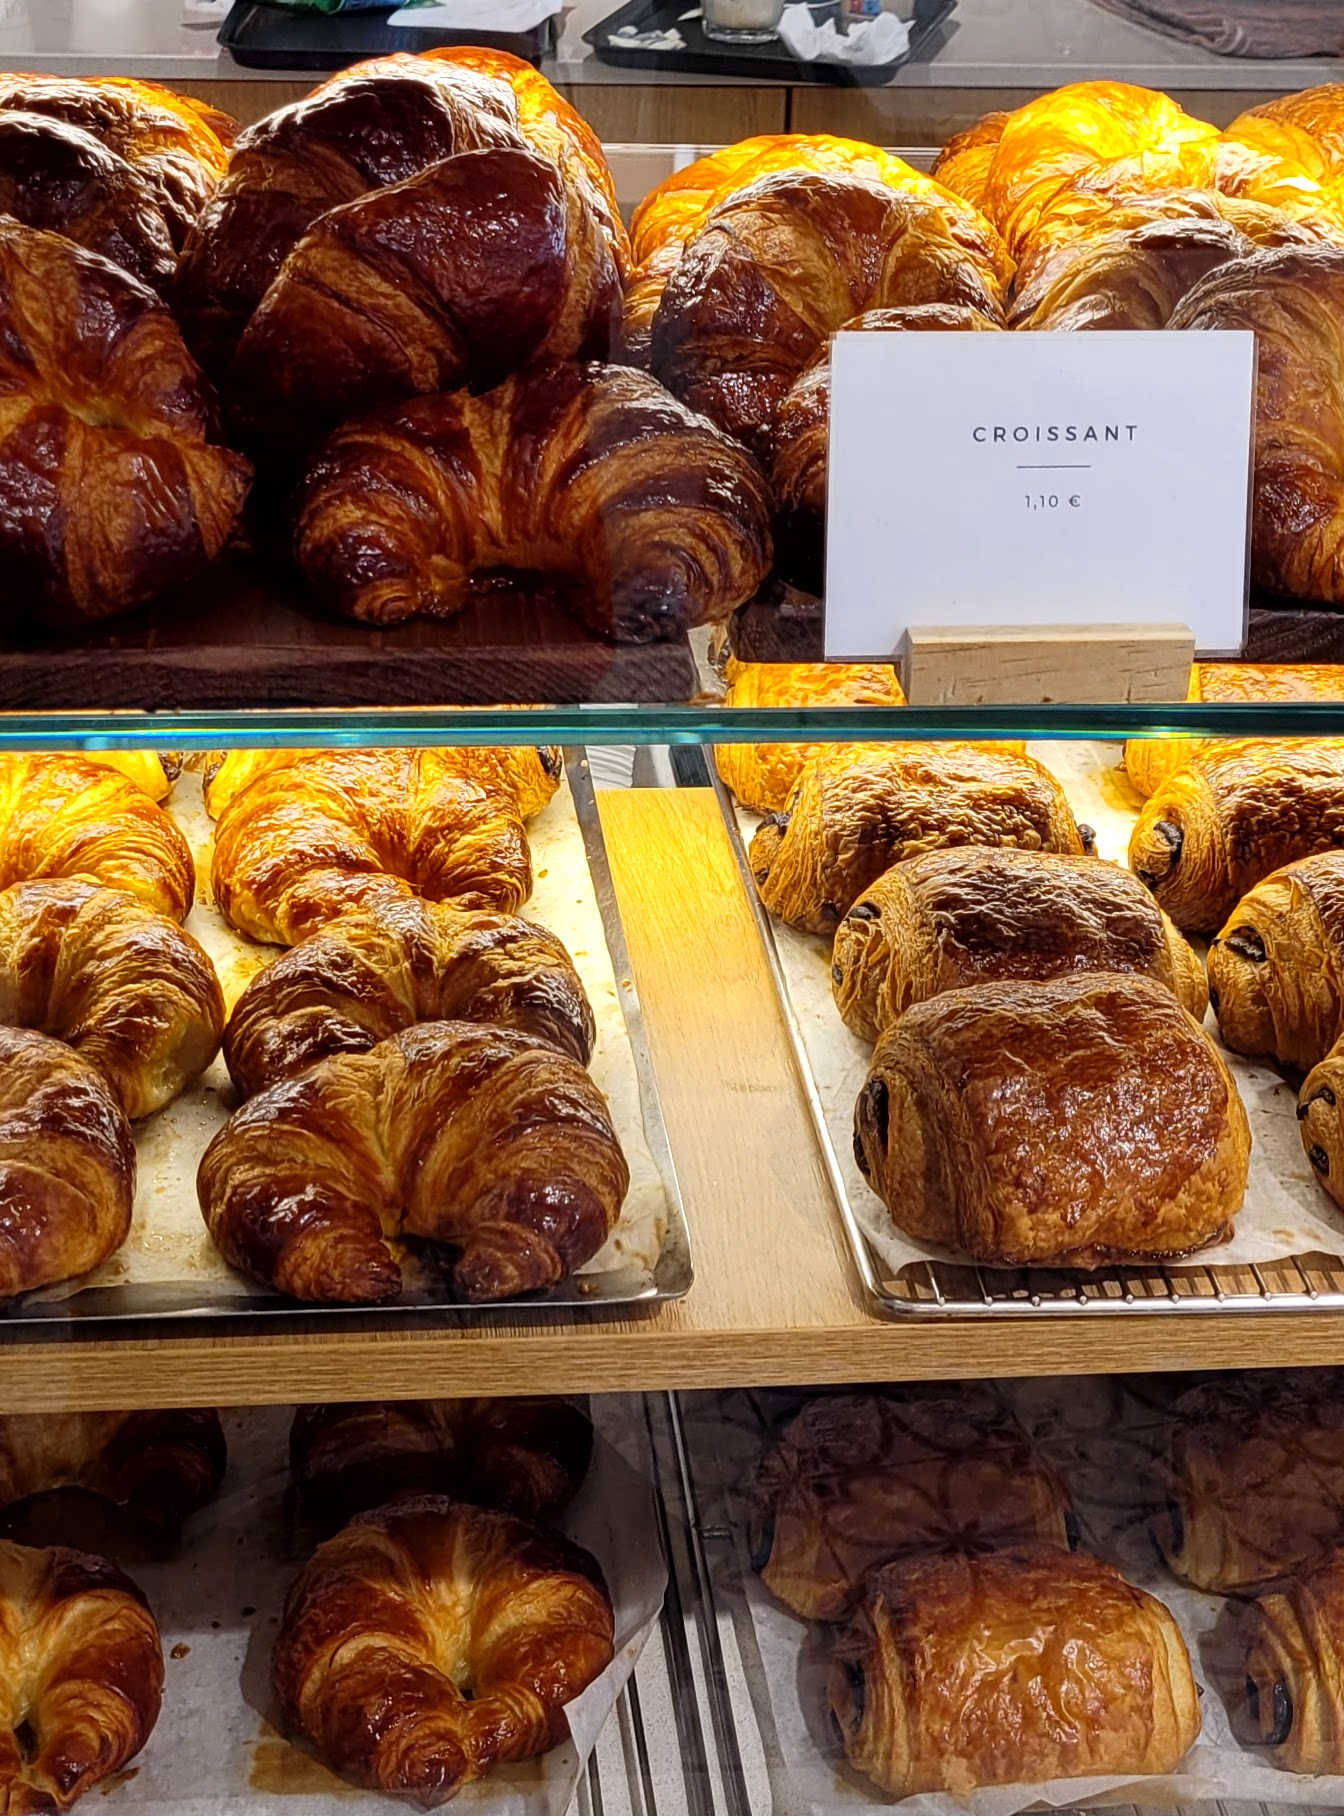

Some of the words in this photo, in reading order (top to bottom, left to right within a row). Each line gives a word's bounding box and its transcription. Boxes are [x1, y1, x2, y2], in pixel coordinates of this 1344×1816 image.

[972, 425, 1138, 442] CROISSANT
[1025, 495, 1059, 510] 1,10
[1069, 495, 1081, 508] €
